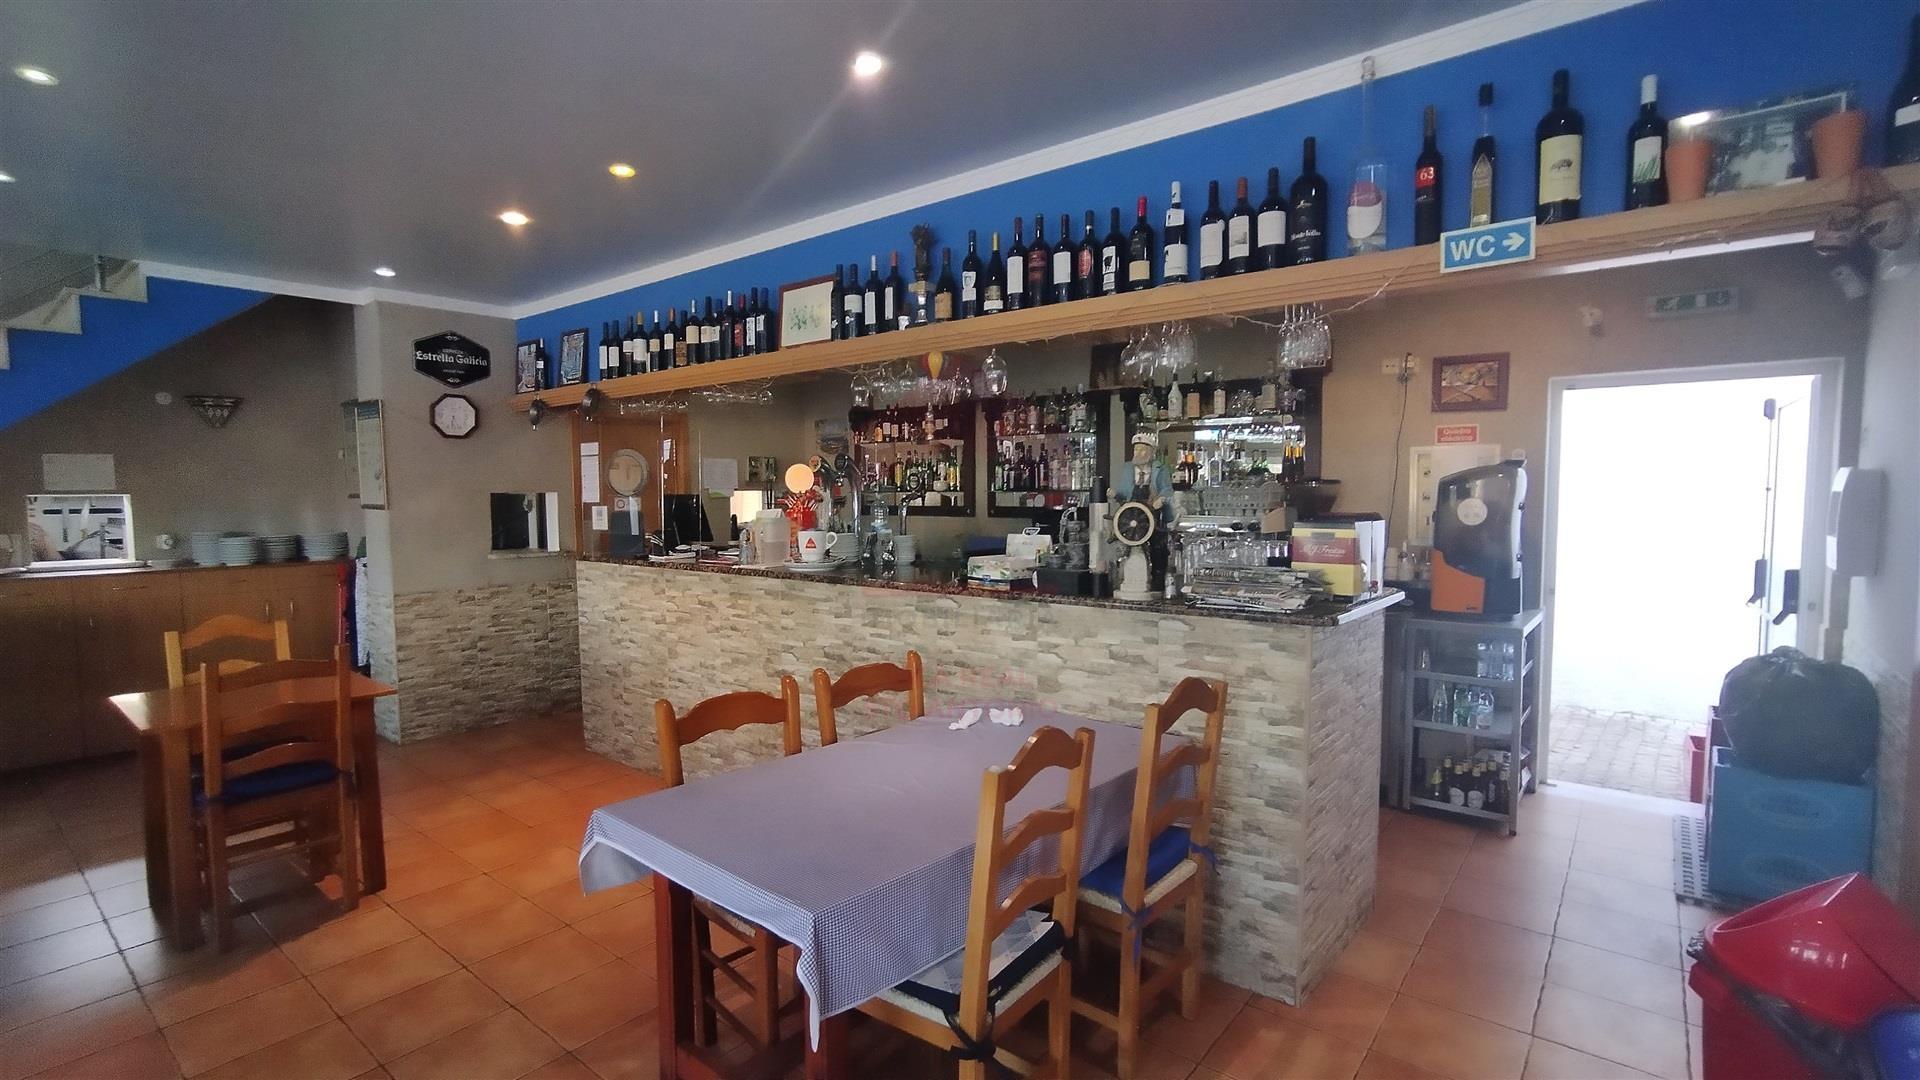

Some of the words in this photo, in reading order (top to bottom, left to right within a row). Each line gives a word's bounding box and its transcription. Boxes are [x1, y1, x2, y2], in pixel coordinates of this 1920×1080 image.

[1420, 166, 1436, 181] 63
[1450, 234, 1496, 261] WC
[415, 350, 454, 363] Estrella
[455, 353, 488, 366] Galicia
